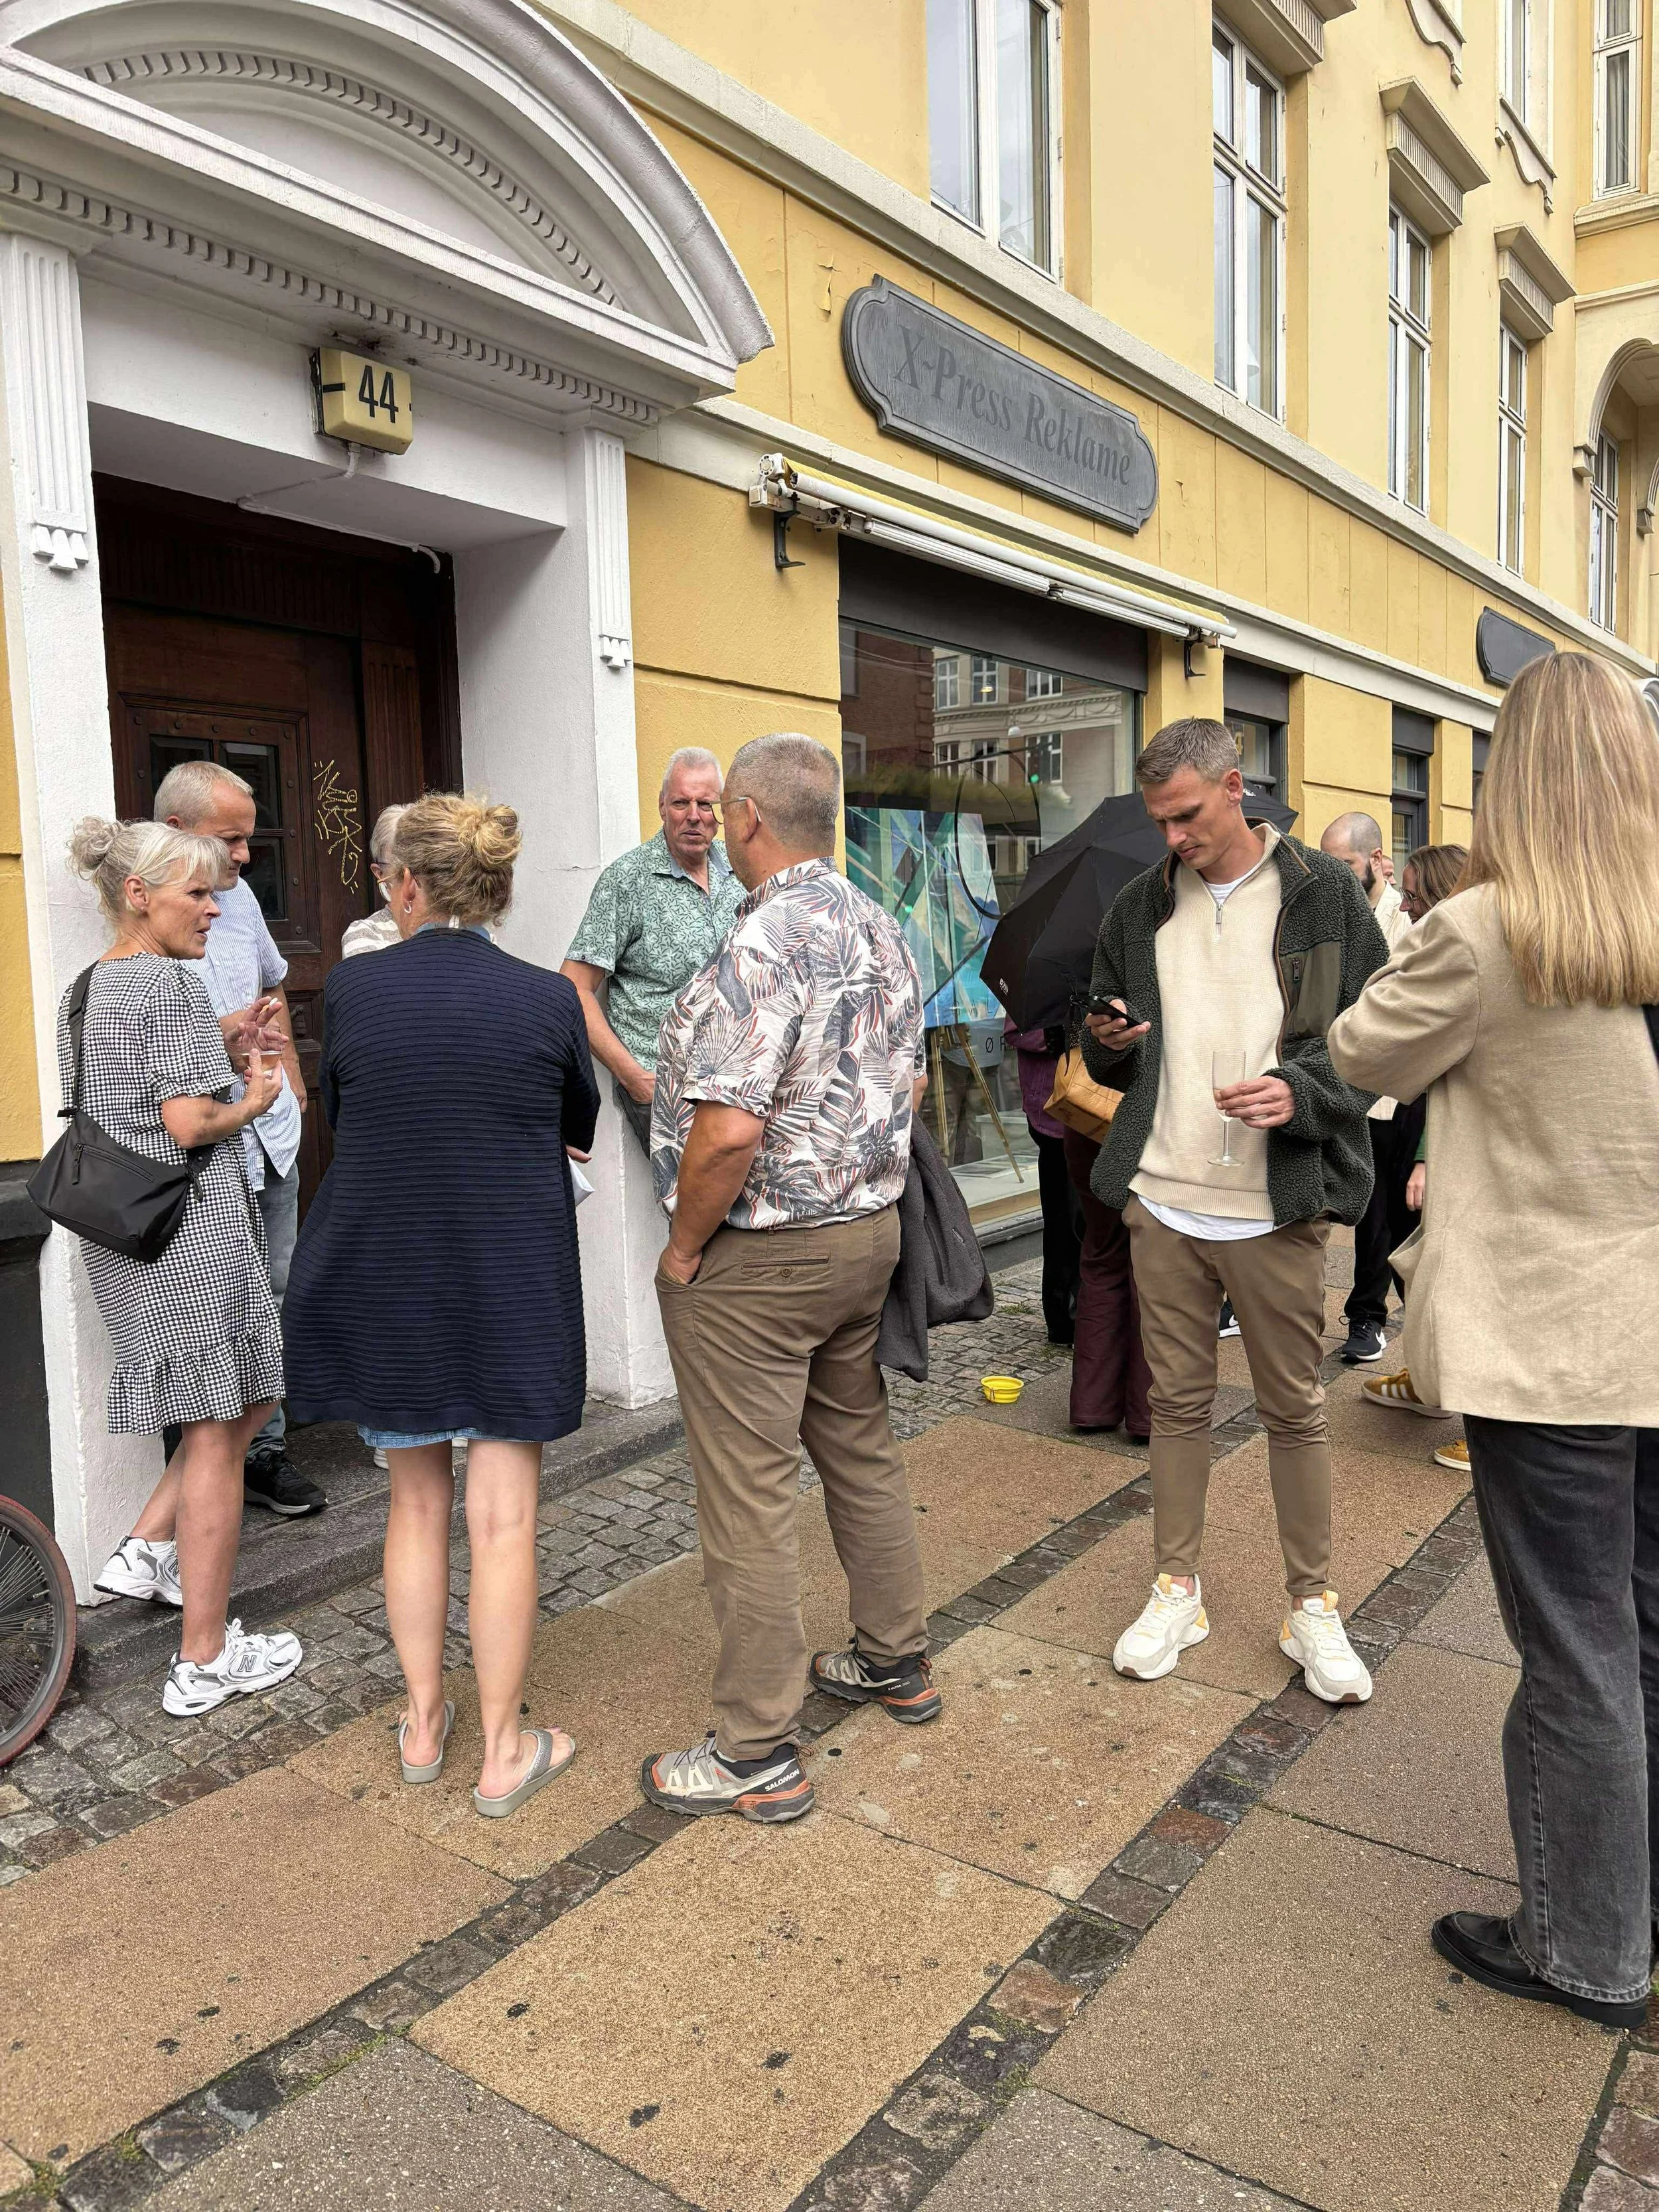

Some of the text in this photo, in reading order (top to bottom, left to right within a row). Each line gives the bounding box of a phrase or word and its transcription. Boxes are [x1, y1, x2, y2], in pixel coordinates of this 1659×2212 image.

[358, 365, 399, 423] 44
[893, 324, 1132, 486] X-Press Reklame
[764, 1768, 800, 1792] SALOMON
